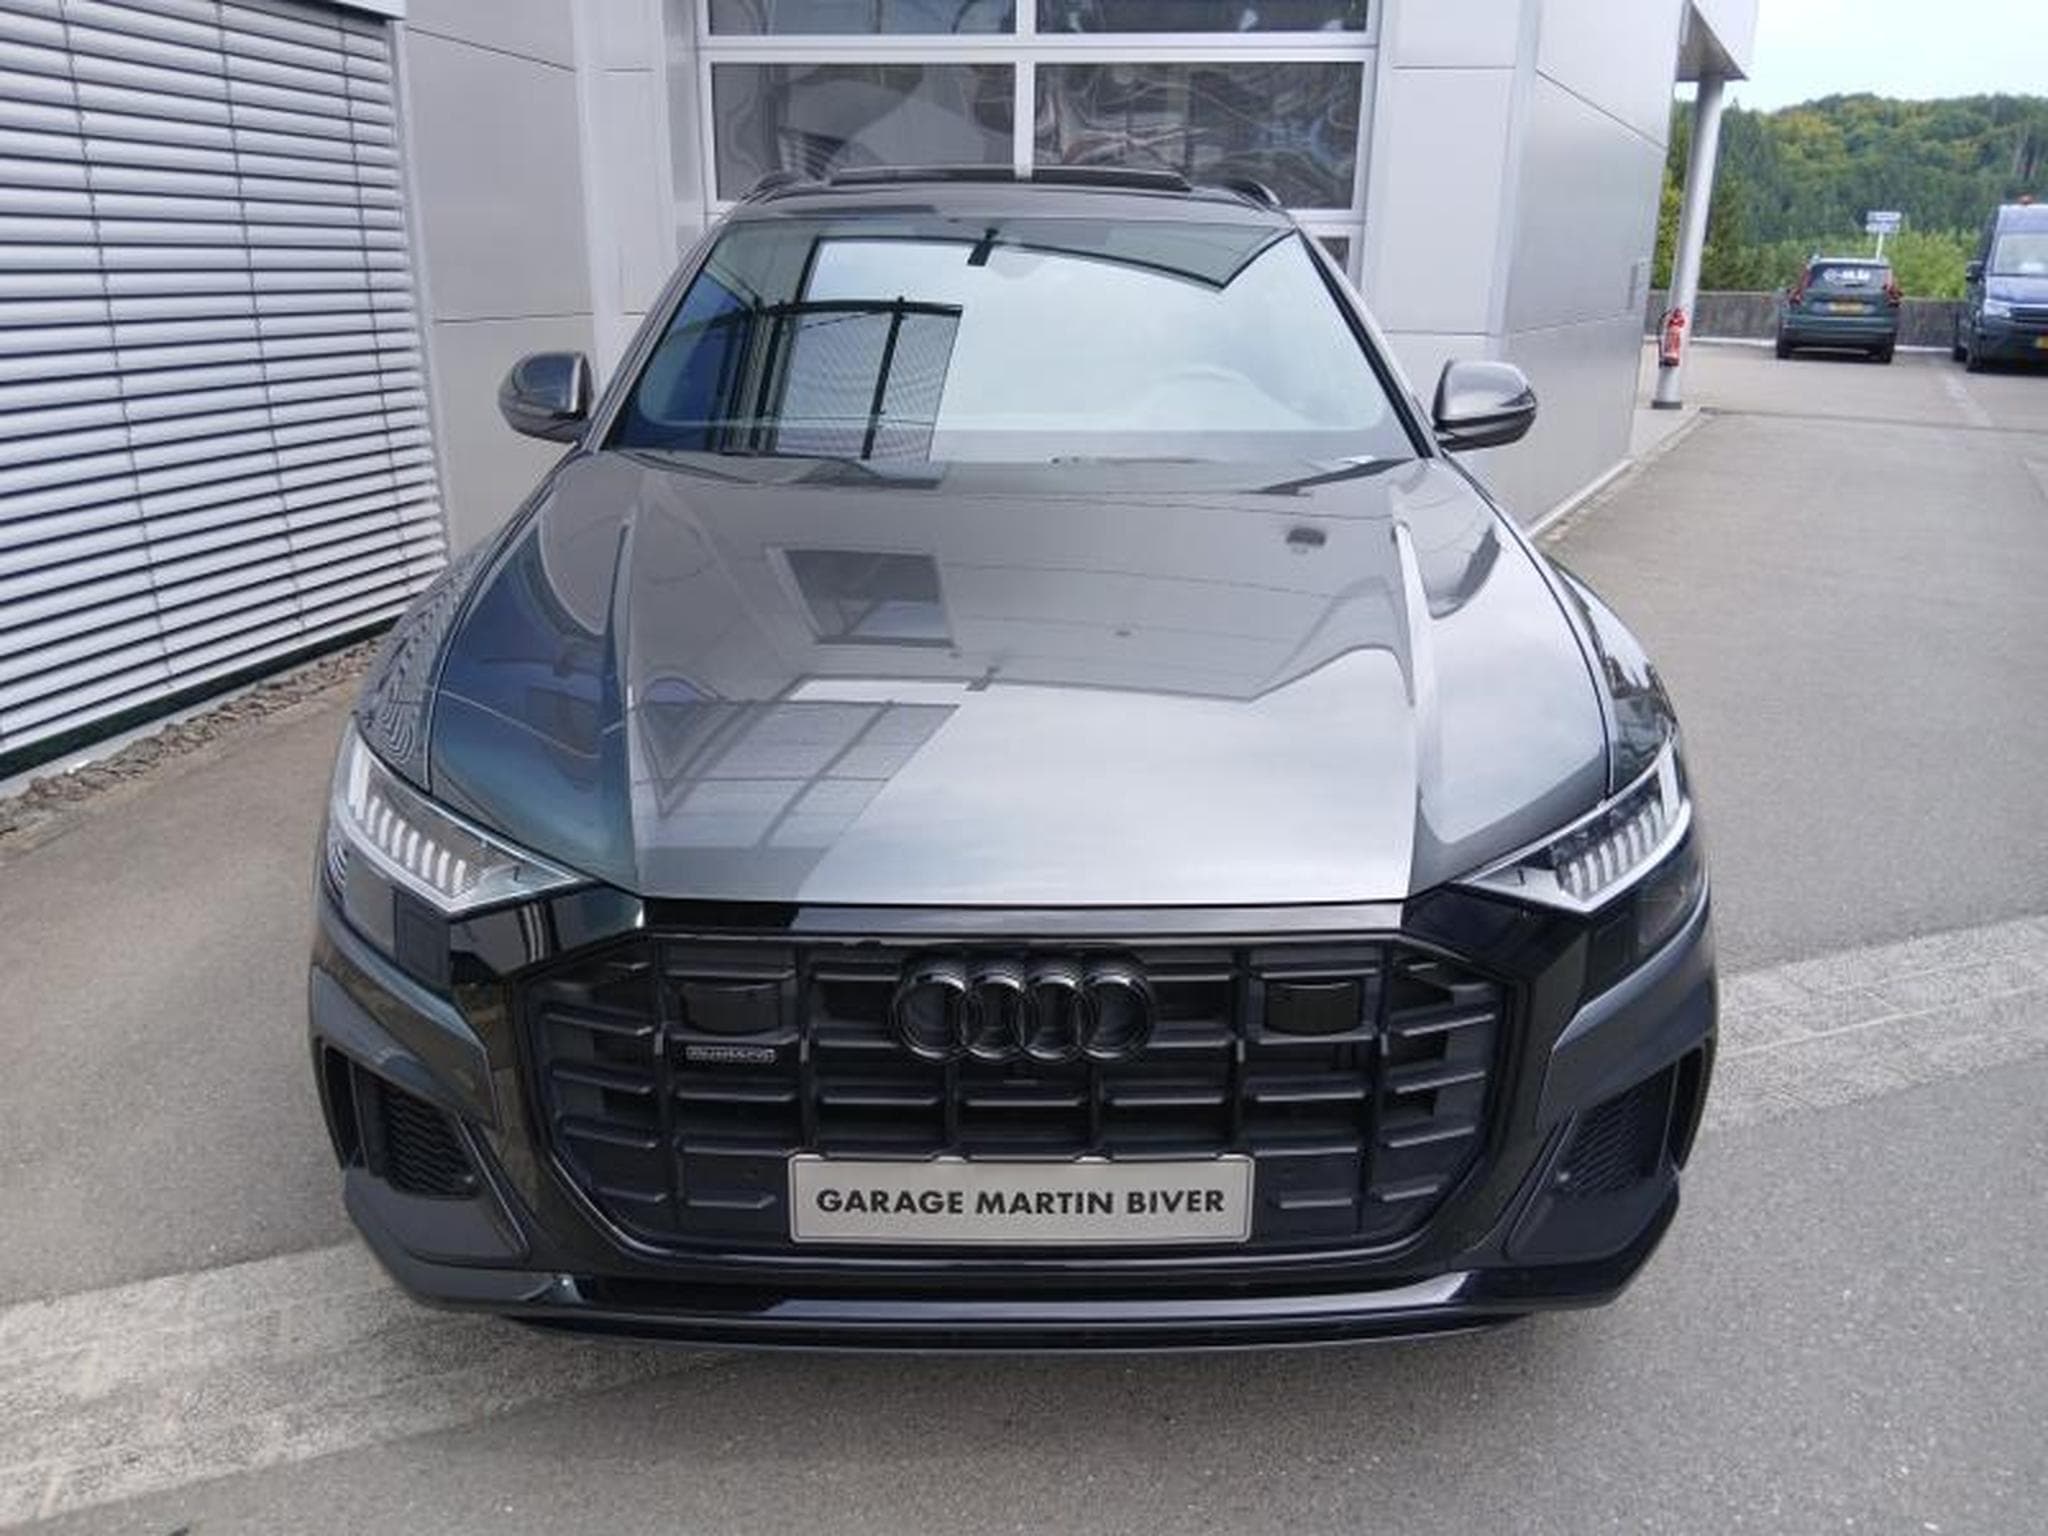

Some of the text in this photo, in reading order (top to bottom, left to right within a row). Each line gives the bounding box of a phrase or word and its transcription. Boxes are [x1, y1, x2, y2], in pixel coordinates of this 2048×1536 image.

[816, 1189, 1224, 1214] GARAGE MARTIN BIVER
